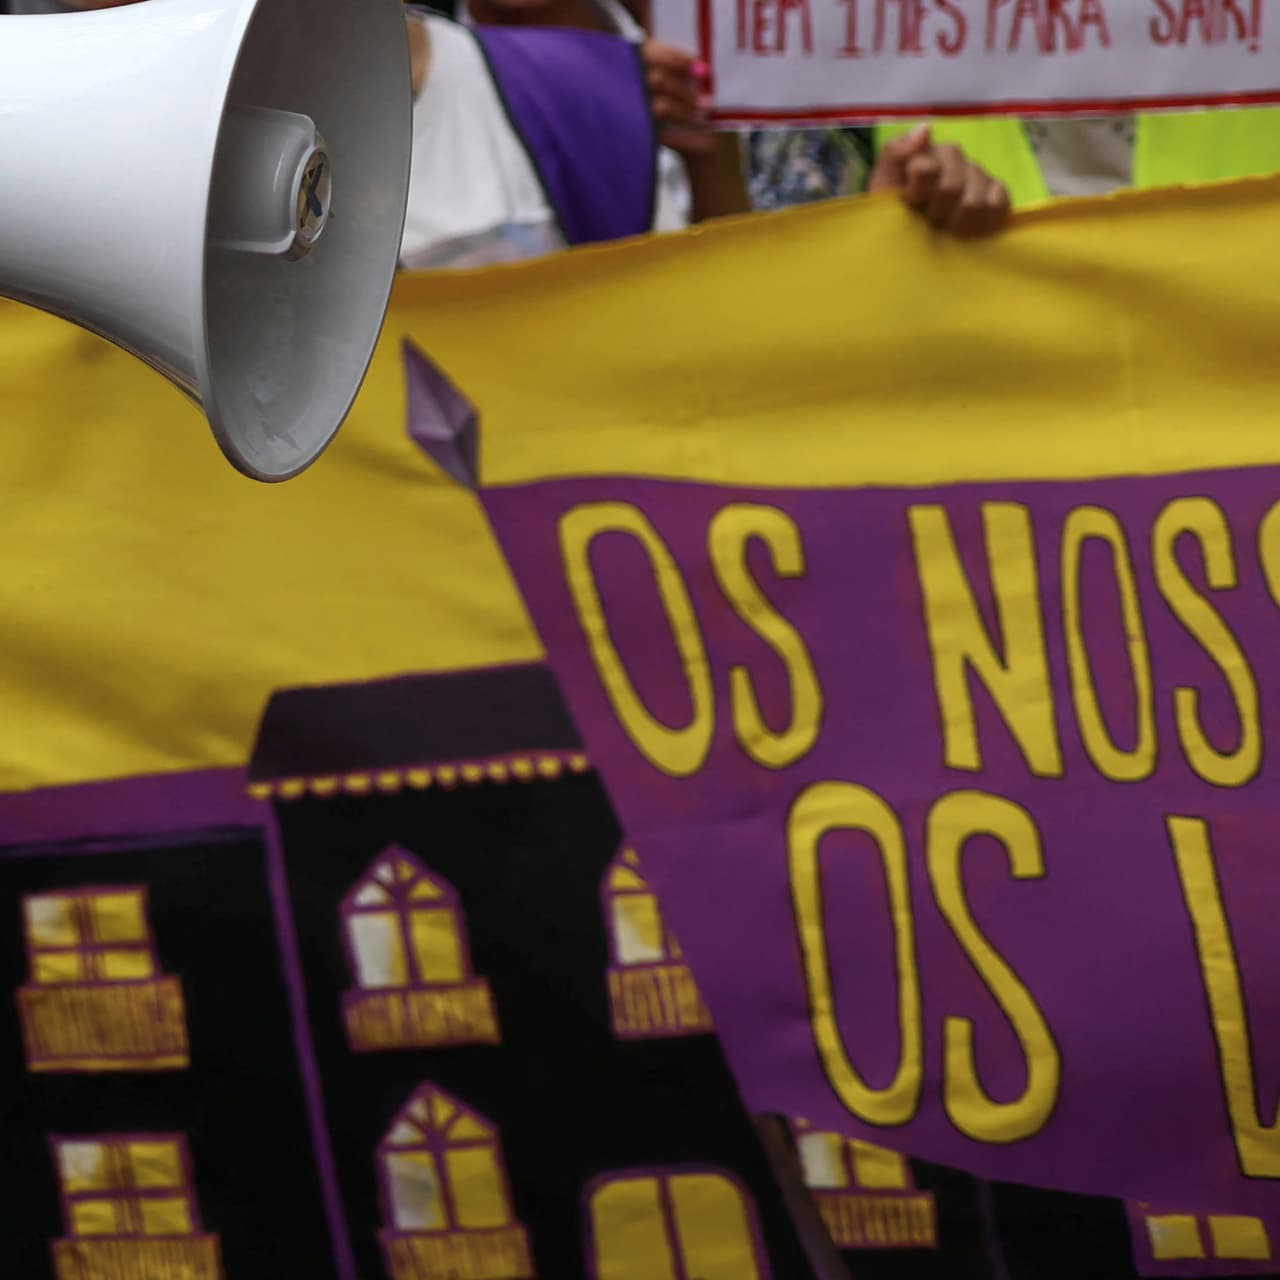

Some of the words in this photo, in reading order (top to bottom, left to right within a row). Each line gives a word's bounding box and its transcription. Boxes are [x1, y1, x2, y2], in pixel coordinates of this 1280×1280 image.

[556, 499, 825, 777] OS
[905, 496, 1280, 788] NOS
[785, 780, 1063, 1145] OS
